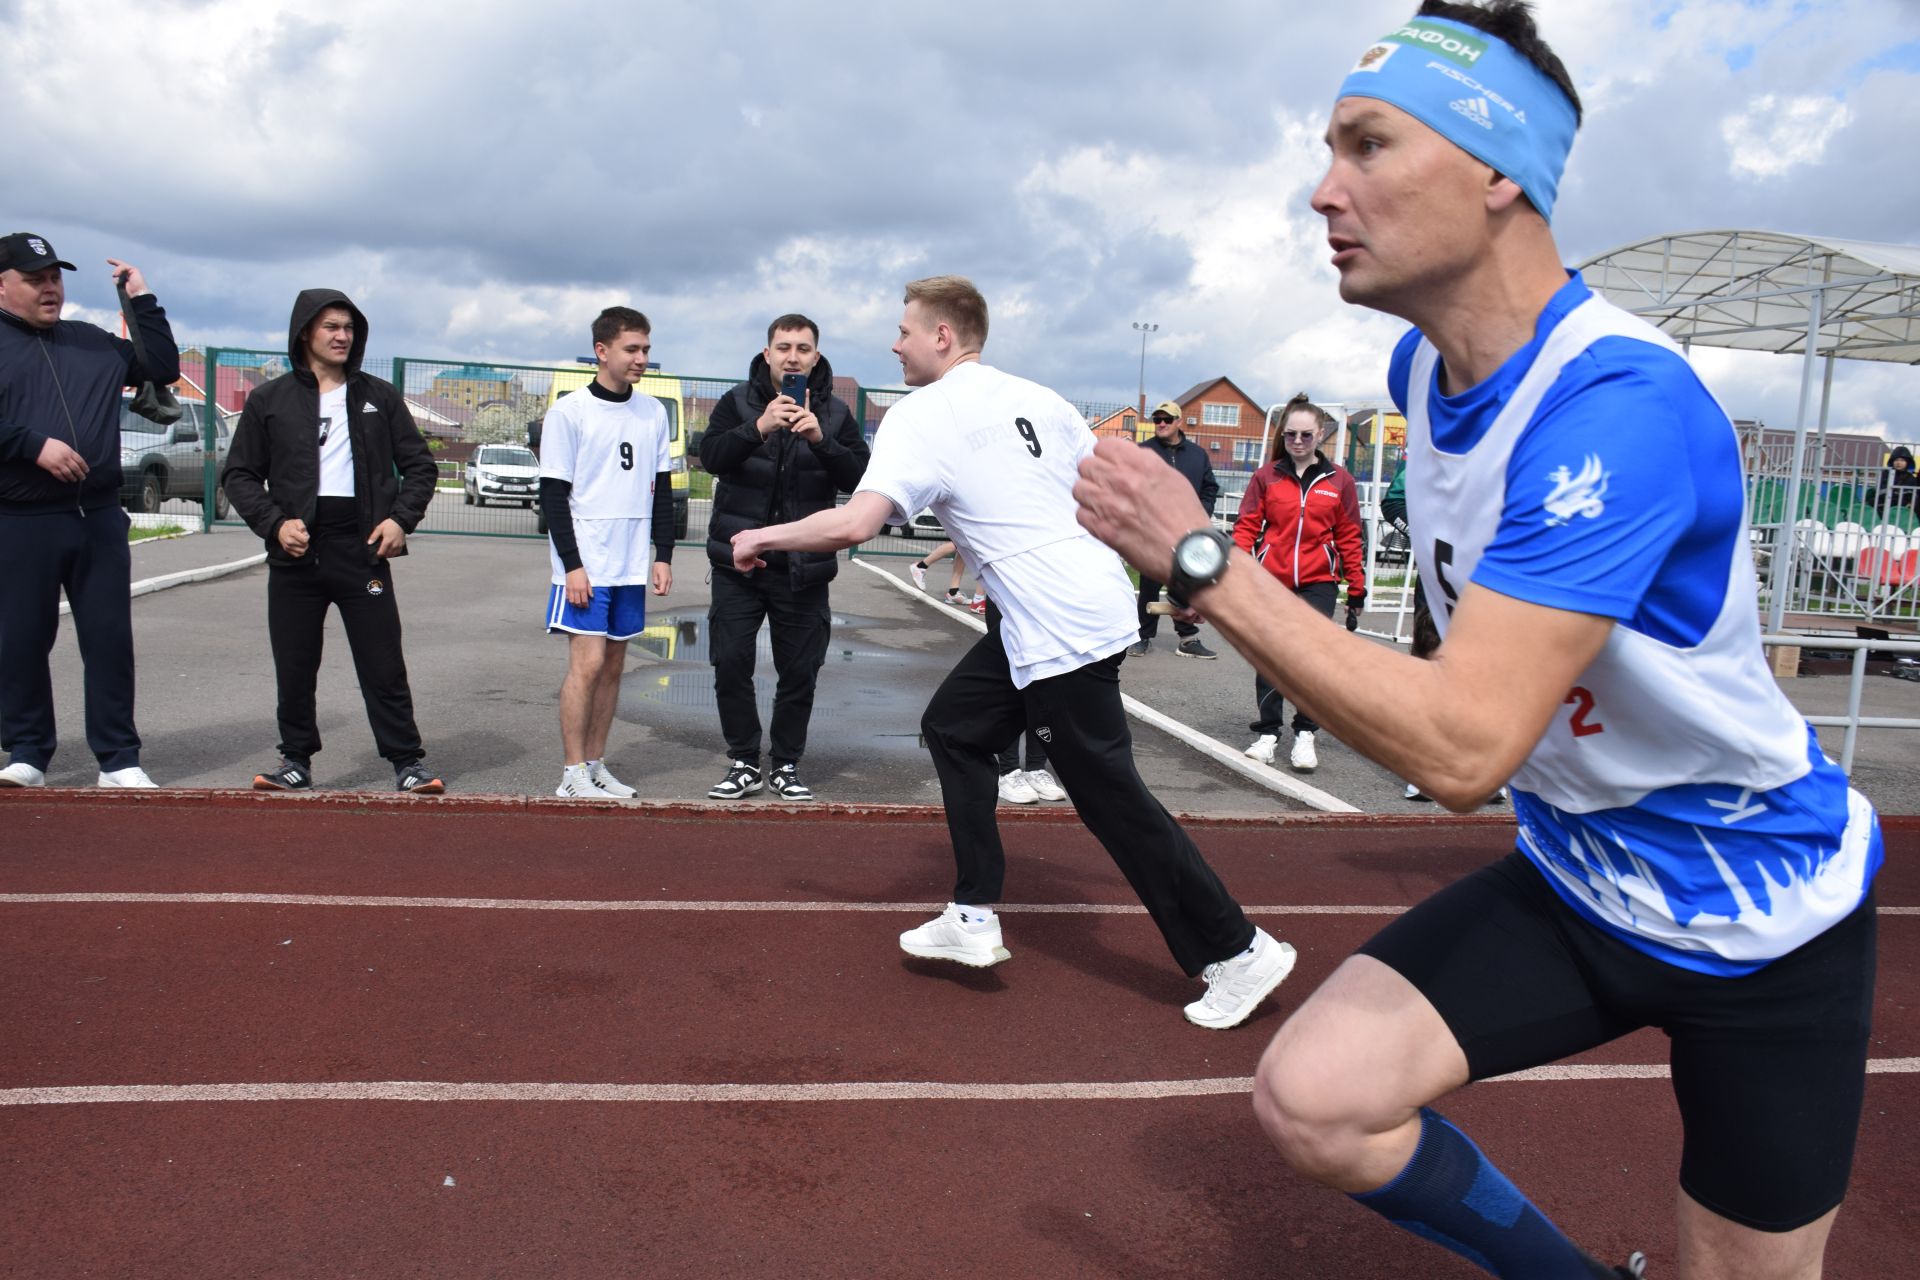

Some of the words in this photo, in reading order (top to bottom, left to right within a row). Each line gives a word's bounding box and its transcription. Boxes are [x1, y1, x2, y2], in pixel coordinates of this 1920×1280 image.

[1425, 61, 1515, 112] FISCHER
[1449, 101, 1494, 130] adidas
[620, 442, 633, 470] 9
[1015, 417, 1042, 458] 9
[1563, 686, 1604, 737] 2
